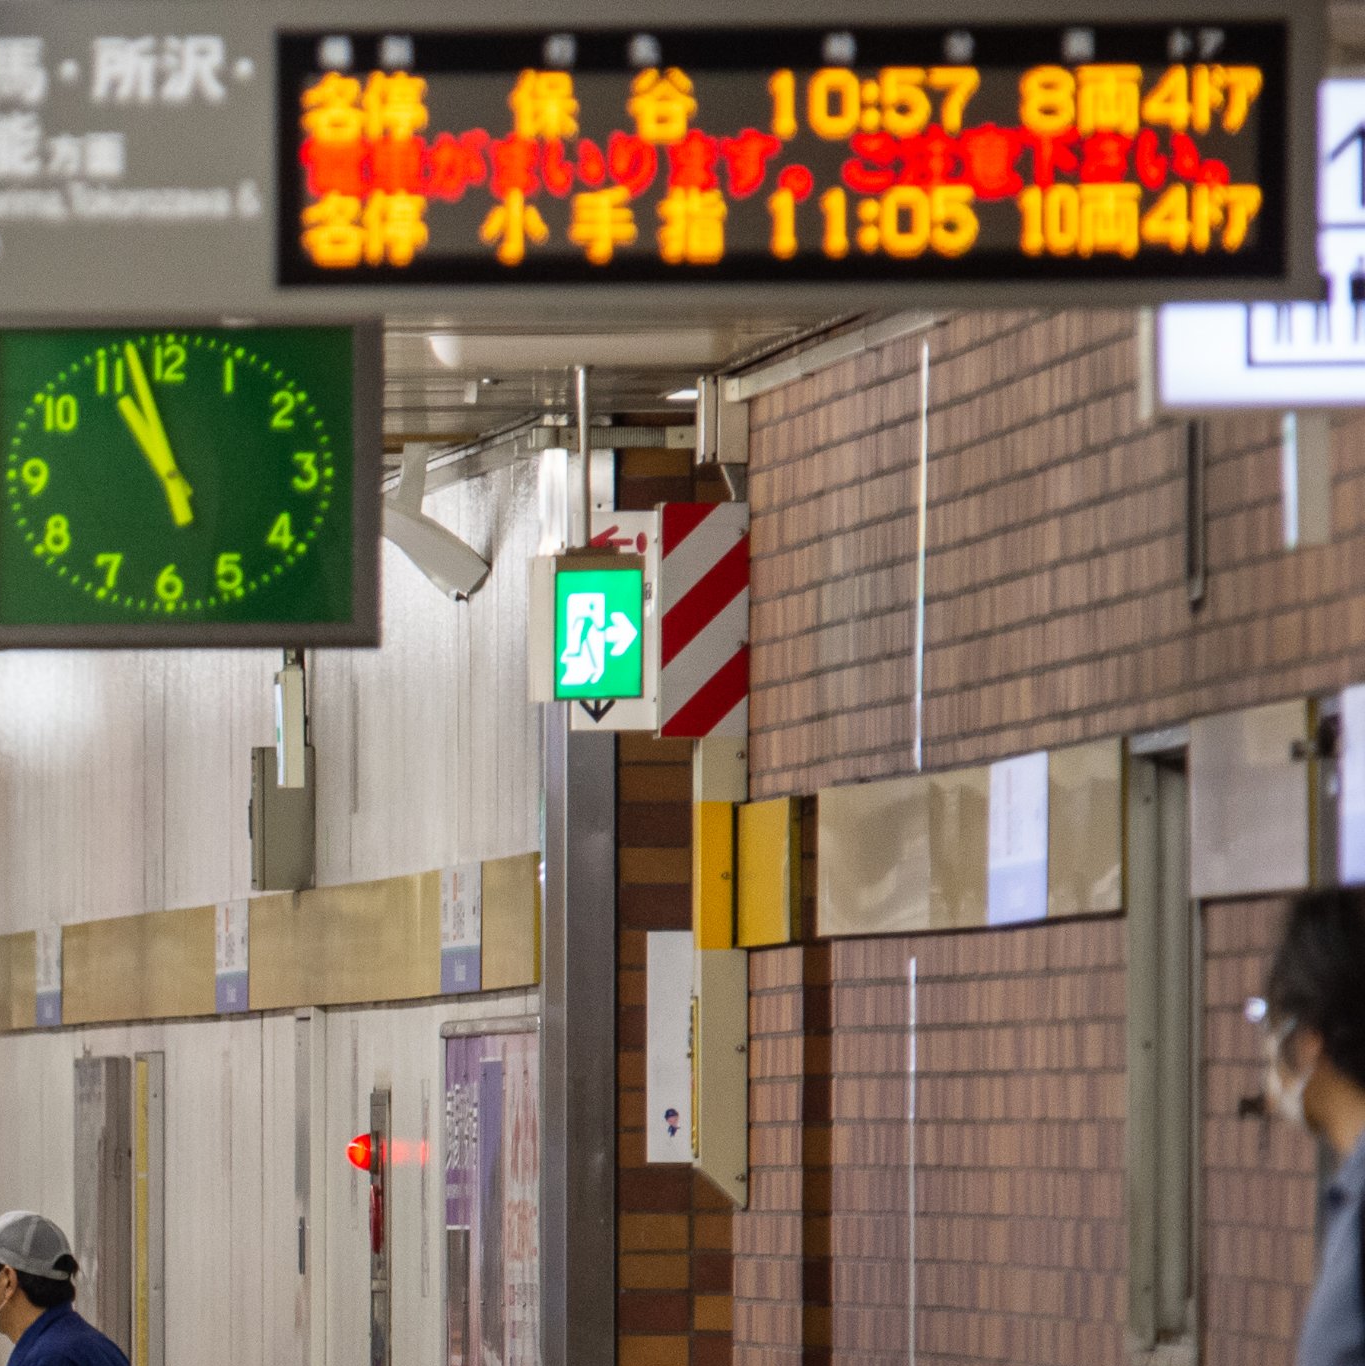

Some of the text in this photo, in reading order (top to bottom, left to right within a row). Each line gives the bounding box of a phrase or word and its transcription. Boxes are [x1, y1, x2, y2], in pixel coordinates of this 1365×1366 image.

[769, 66, 981, 140] 10:57
[769, 184, 980, 259] 11:05
[97, 352, 125, 396] 11
[154, 344, 187, 383] 12
[223, 355, 235, 395] 1
[43, 393, 78, 432] 10
[270, 390, 296, 429] 2
[21, 457, 49, 496] 9
[292, 451, 319, 491] 3
[44, 513, 70, 554] 8
[267, 511, 295, 550] 4
[95, 552, 124, 590] 7
[156, 563, 184, 601] 6
[215, 552, 243, 591] 5
